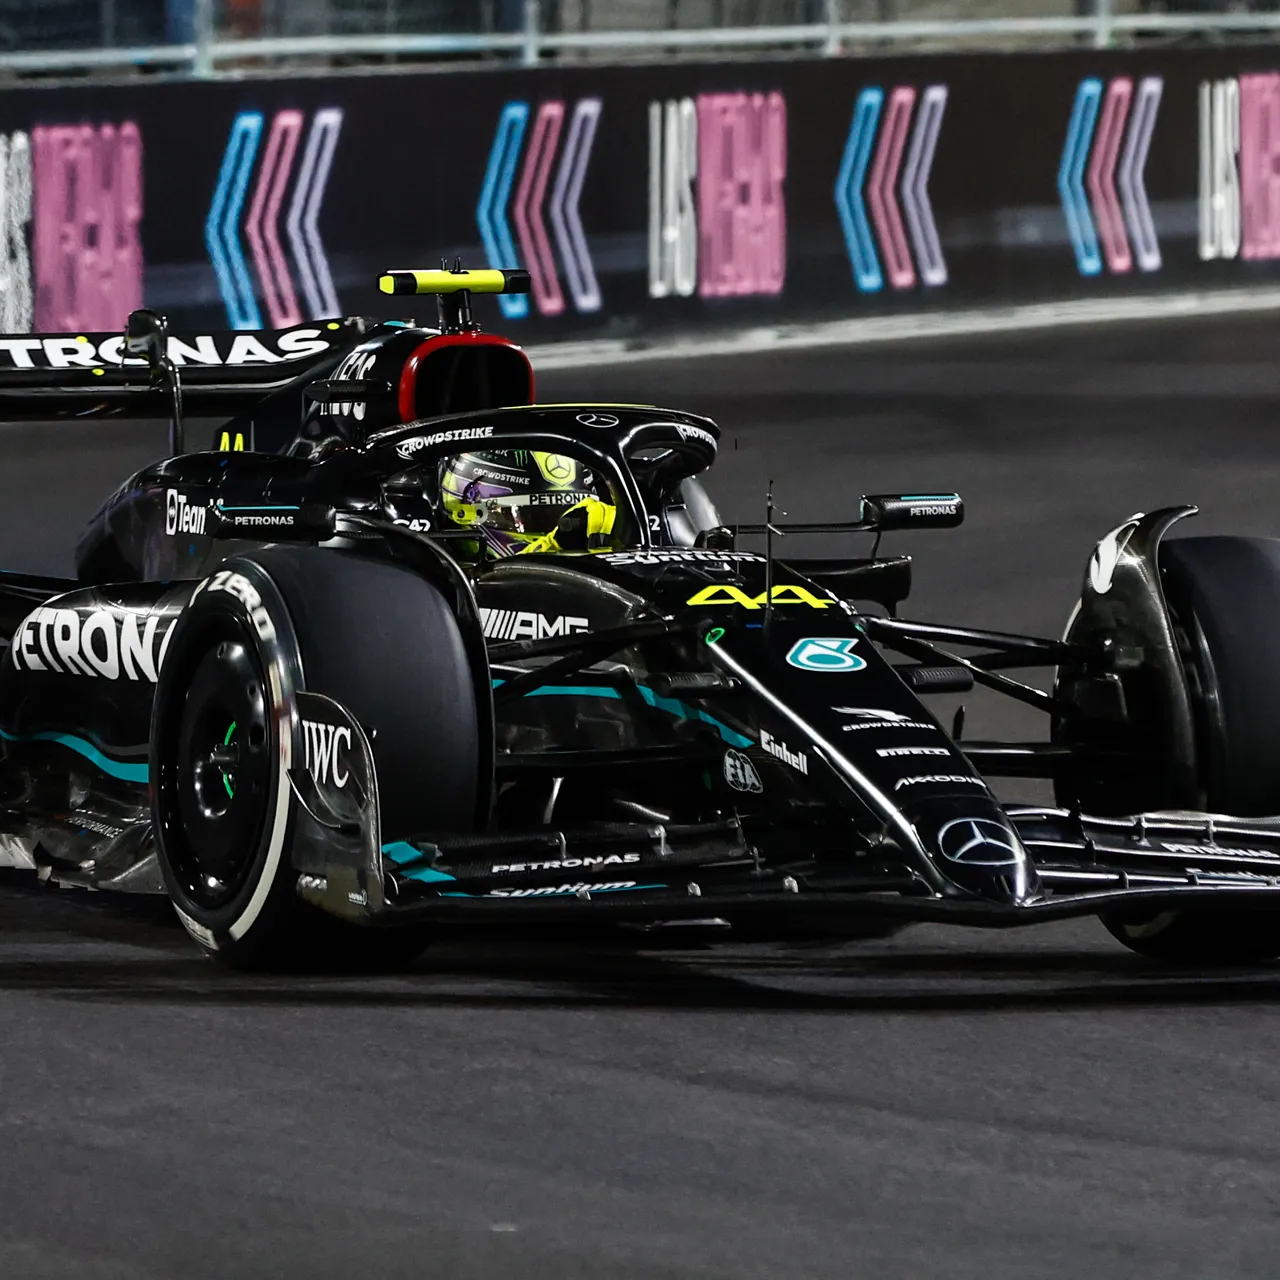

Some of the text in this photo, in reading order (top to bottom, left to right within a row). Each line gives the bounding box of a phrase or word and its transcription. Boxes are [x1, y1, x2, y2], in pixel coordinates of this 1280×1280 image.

[401, 426, 494, 456] CROWDSTRIKE
[473, 467, 531, 486] CROWDSTRIKE
[529, 493, 591, 506] PETRON
[910, 505, 957, 517] PETRONAS
[234, 516, 294, 526] PETRONAS
[207, 570, 277, 645] ZERO
[686, 584, 837, 610] 44
[12, 606, 178, 683] PETRON
[842, 721, 937, 732] CROWDSTRIKE
[302, 719, 352, 788] IWC
[759, 728, 808, 776] Einhell
[724, 753, 761, 789] FIA
[491, 852, 641, 874] PETRONAS
